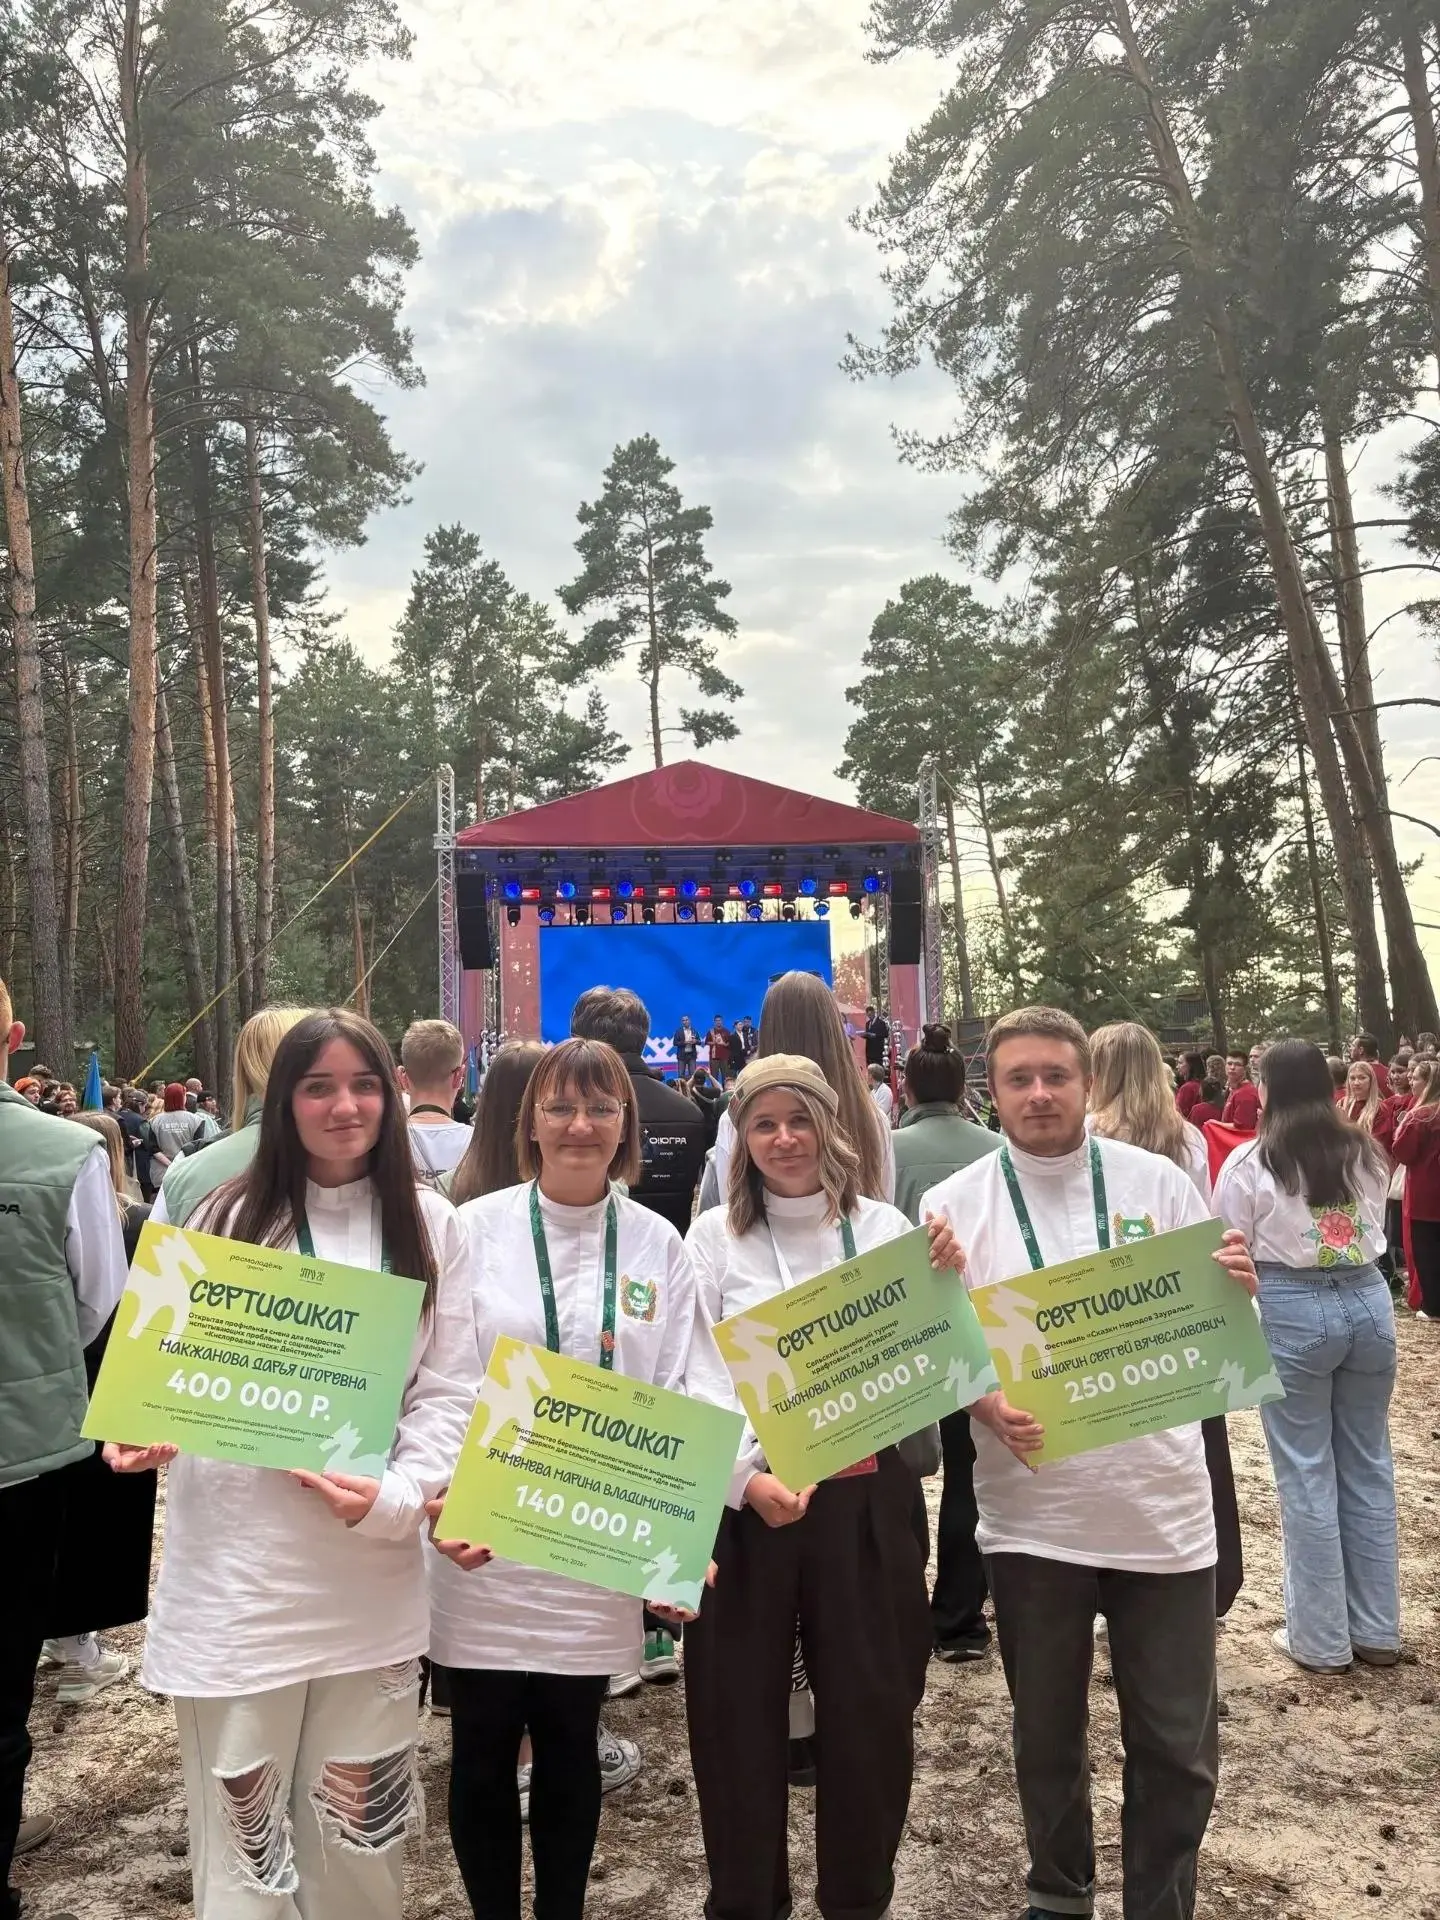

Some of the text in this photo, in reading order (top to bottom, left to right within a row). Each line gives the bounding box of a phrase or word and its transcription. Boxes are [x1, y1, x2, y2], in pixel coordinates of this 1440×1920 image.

[187, 1312, 224, 1325] Открытая
[223, 1319, 268, 1335] профильная
[268, 1328, 290, 1338] смена
[290, 1333, 304, 1341] для
[189, 1280, 359, 1334] СЕРТИФИКАТ
[777, 1277, 906, 1358] СЕРТИФИКАТ
[1036, 1270, 1181, 1332] СЕРТИФИКАТ
[1043, 1302, 1195, 1351] Фестиваль «Сказки Народов Зауралья»
[188, 1319, 246, 1337] испытывающих
[246, 1331, 283, 1344] проблемы
[288, 1339, 341, 1355] социализацией
[203, 1330, 255, 1346] «Кислородная
[805, 1319, 899, 1369] Сельский семейный турнир
[811, 1328, 896, 1376] крафтовых игр «Грядка»
[1031, 1316, 1225, 1379] ШУШАРИН СЕРГЕЙ ВЯЧЕСЛАВОВИЧ
[158, 1338, 366, 1390] МАКЖАНОВА ДАРЬЯ ИГОРЕВНА
[772, 1319, 951, 1415] ТИХОНОВА НАТАЛЬЯ ЕВГЕНЬЕВНА
[1065, 1372, 1115, 1402] 250
[1122, 1354, 1177, 1385] 000
[167, 1369, 230, 1400] 400
[240, 1382, 301, 1414] 000
[808, 1392, 856, 1429] 200
[862, 1364, 910, 1400] 000
[533, 1396, 684, 1460] СЕРТИФИКАТ
[511, 1424, 556, 1444] Пространство
[557, 1438, 589, 1454] бережной
[589, 1448, 643, 1471] психологической
[649, 1467, 696, 1487] эмоциональной
[518, 1435, 555, 1451] поддержки
[555, 1446, 567, 1454] для
[568, 1450, 596, 1463] сельских
[597, 1459, 625, 1472] молодых
[626, 1469, 652, 1481] женщин
[485, 1447, 694, 1522] ЯЧМЕНЕВА МАРИНА ВЛАДИМИРОВНА
[516, 1485, 563, 1517] 140
[572, 1502, 626, 1536] 000
